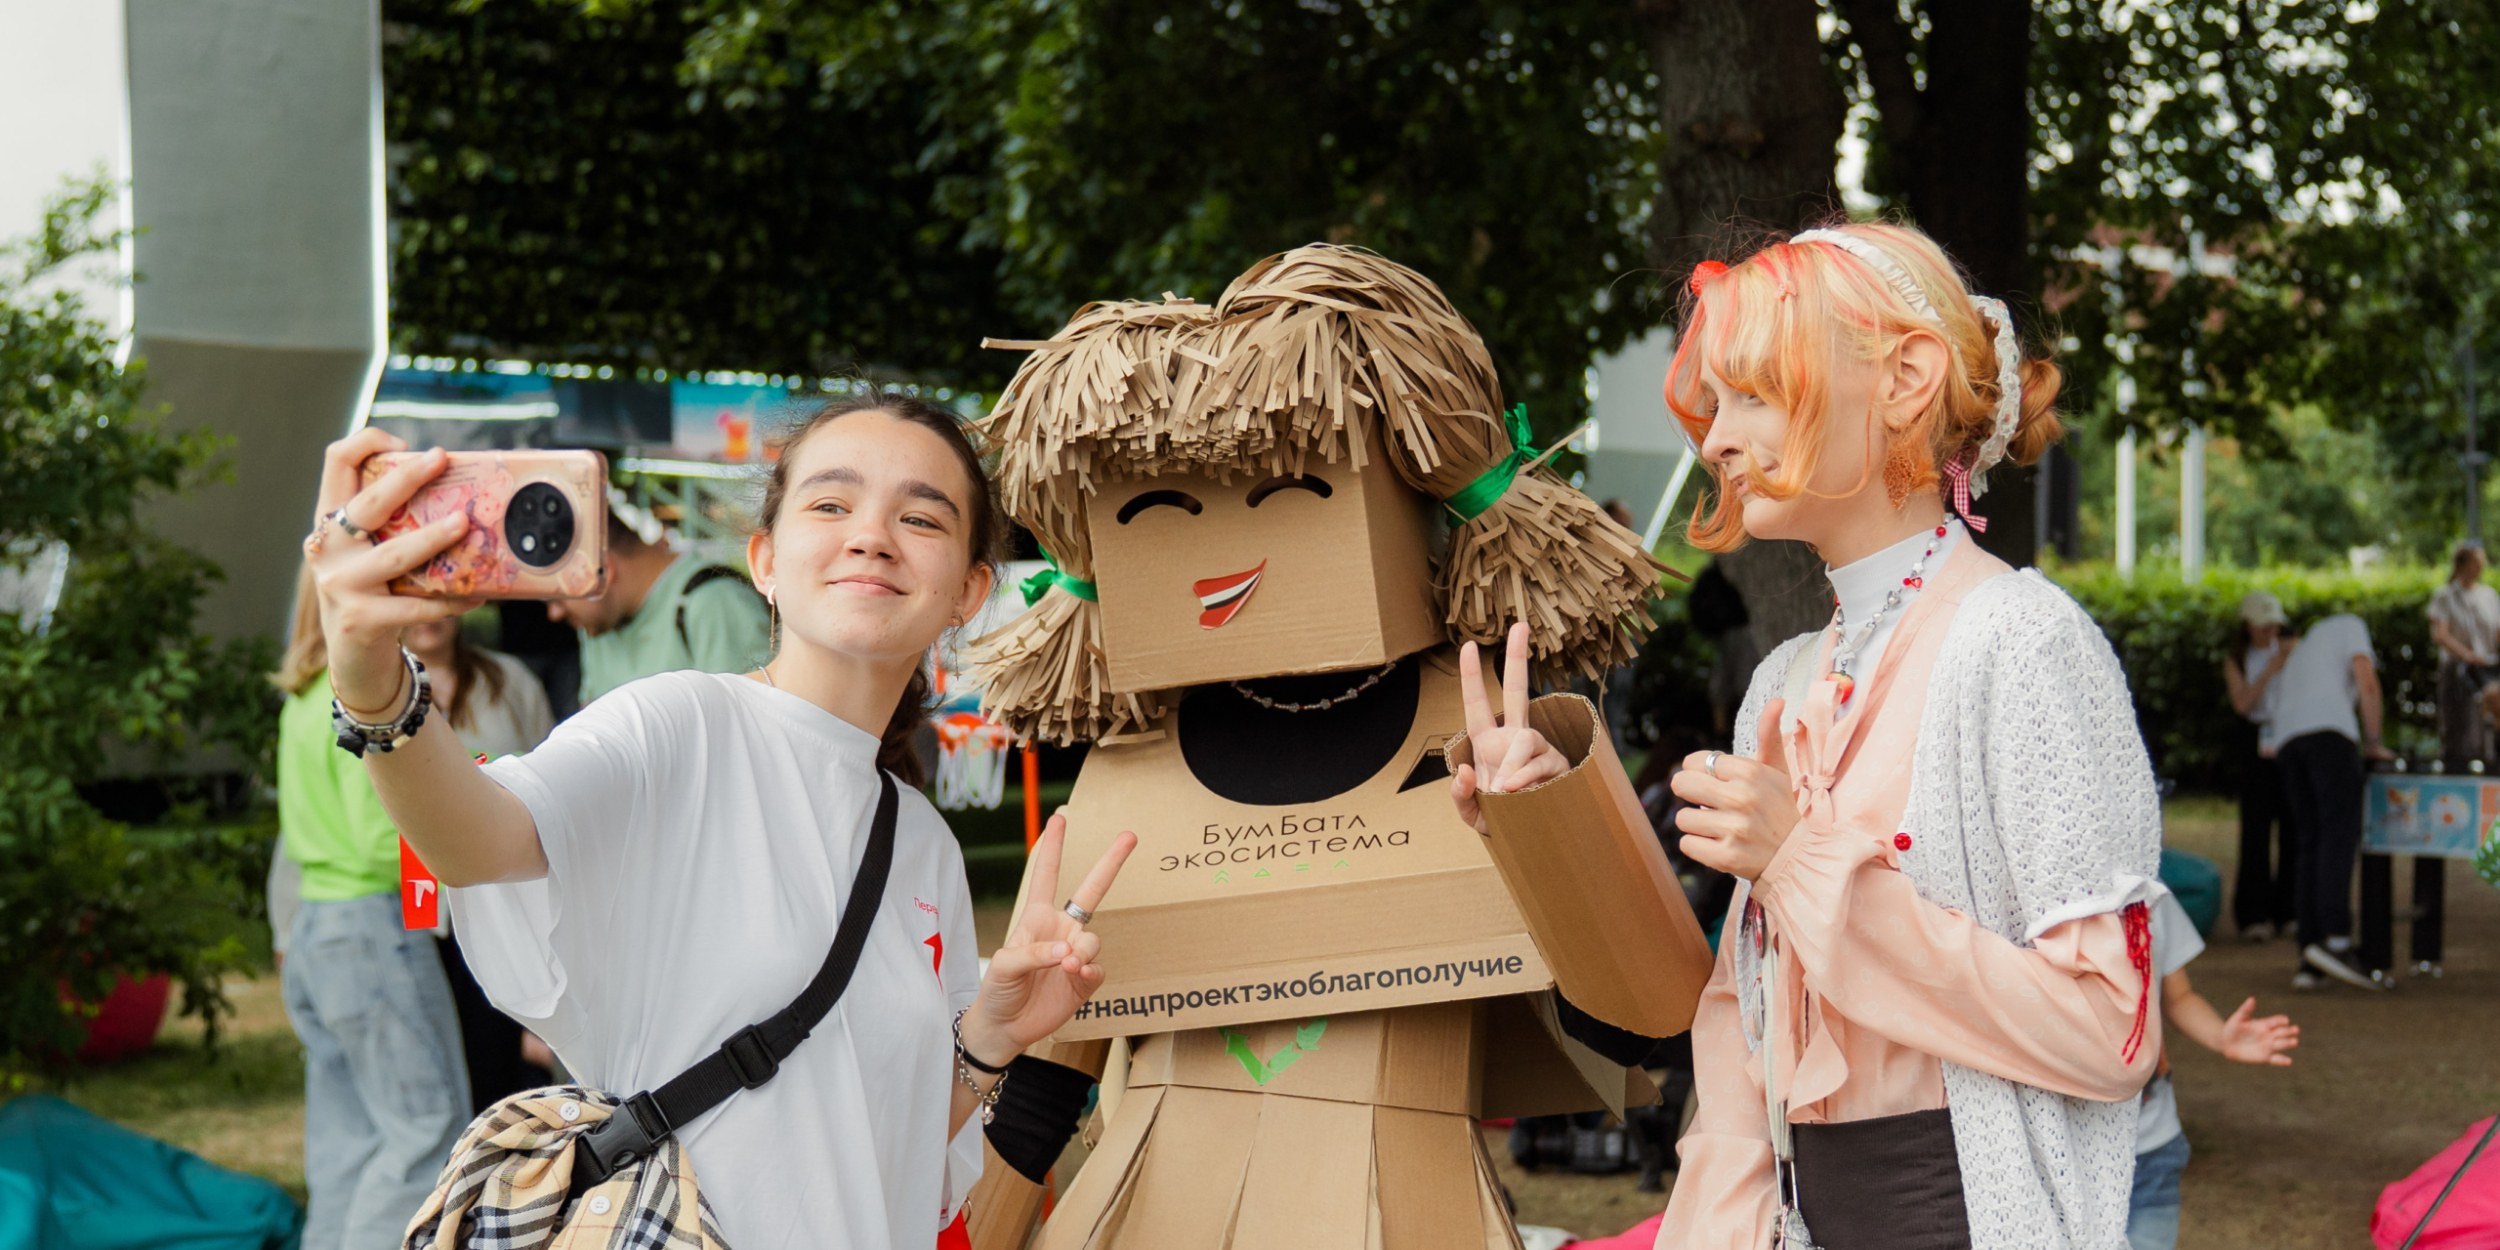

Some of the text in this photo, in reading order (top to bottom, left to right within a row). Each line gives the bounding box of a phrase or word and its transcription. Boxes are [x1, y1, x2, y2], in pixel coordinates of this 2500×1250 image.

[1159, 830, 1411, 872] экосистема
[1202, 814, 1367, 847] БумБатл
[1074, 955, 1524, 1021] #нацпроектэкоблагополучие
